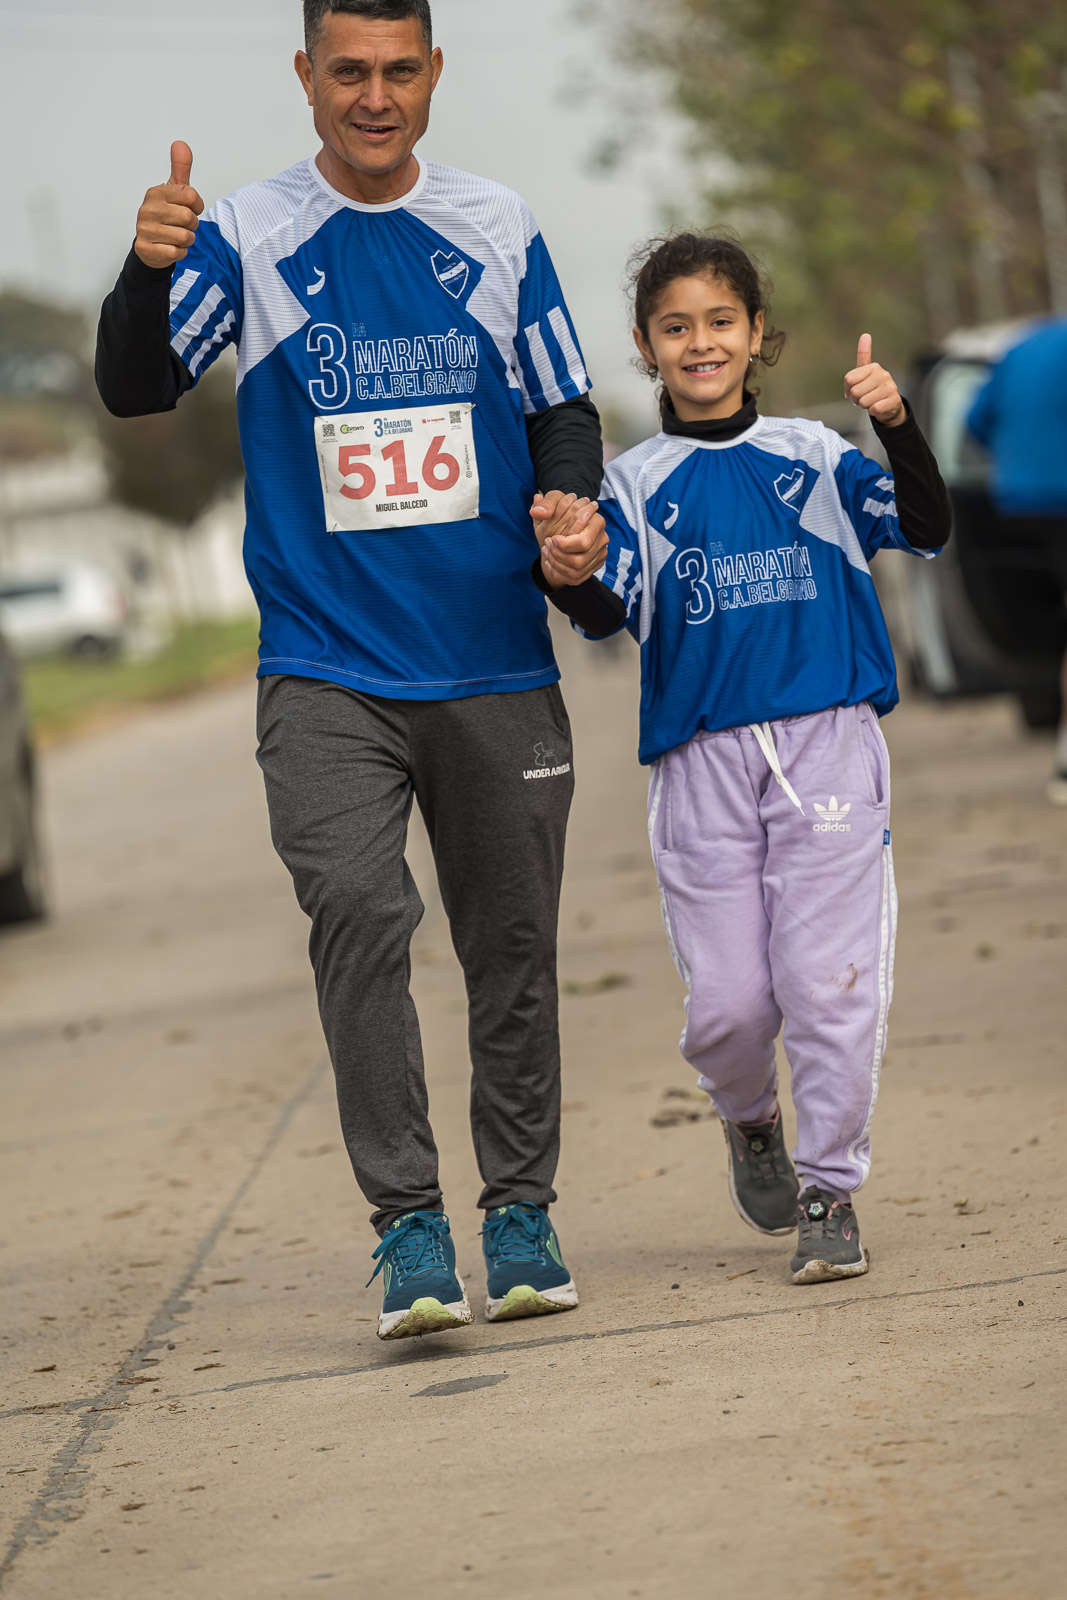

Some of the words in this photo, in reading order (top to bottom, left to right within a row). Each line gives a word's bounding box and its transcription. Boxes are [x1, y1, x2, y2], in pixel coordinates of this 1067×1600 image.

[306, 323, 350, 410] 3
[352, 328, 479, 374] MARATÓN
[373, 418, 384, 438] 3
[383, 419, 412, 429] MARATÓN
[338, 435, 460, 500] 516
[375, 504, 400, 512] MIGUEL
[400, 499, 428, 510] BALCEDO
[712, 540, 813, 589] MARATÓN
[675, 547, 714, 625] 3
[523, 768, 550, 779] UNDER
[812, 822, 851, 832] adidas
